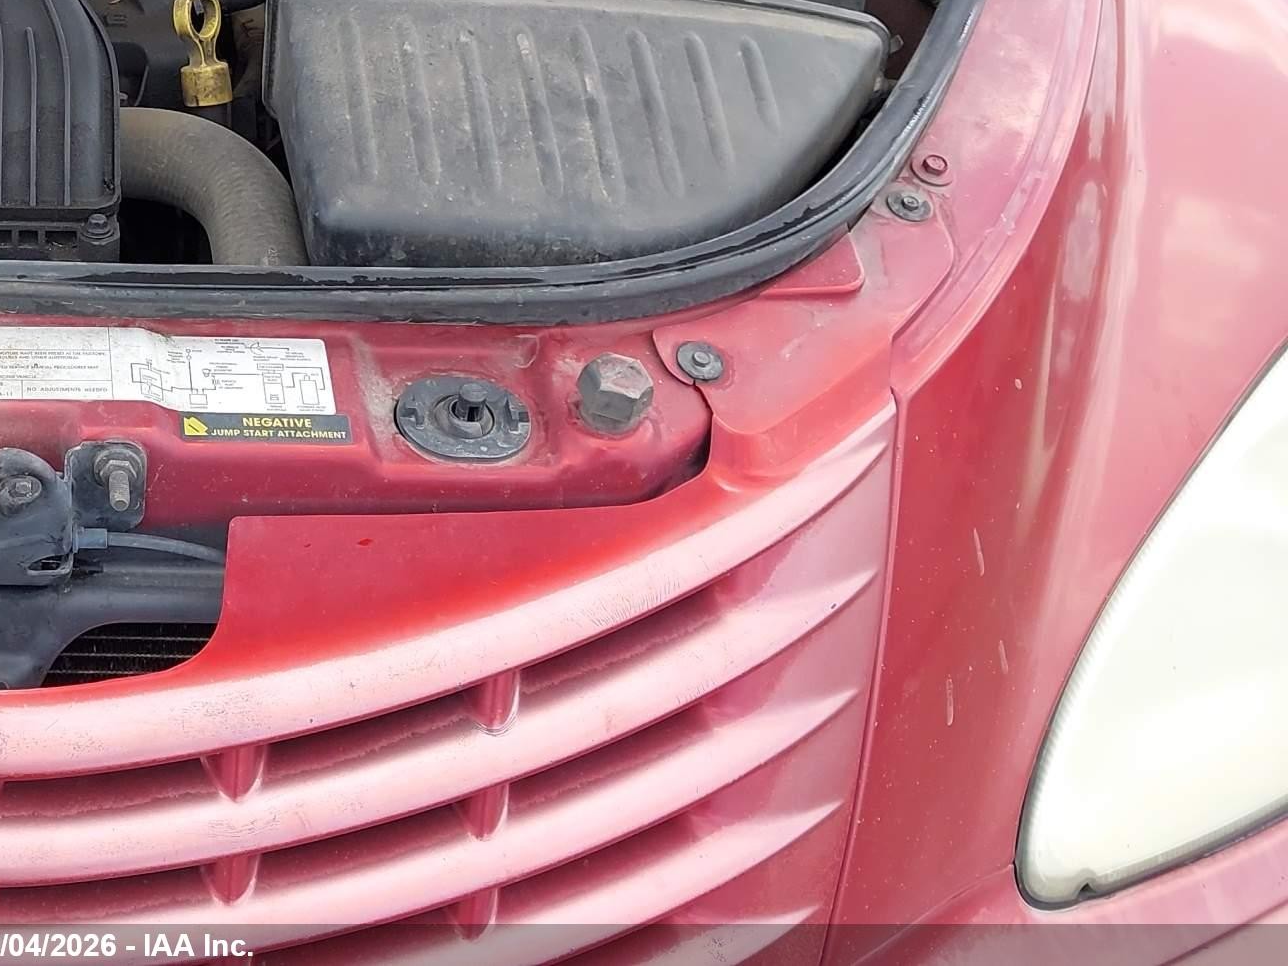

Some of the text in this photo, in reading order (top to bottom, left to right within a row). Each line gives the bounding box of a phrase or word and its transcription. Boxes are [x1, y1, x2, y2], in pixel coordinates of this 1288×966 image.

[242, 417, 312, 428] NEGATIVE
[211, 428, 346, 439] JUMP START ATTACHMENT
